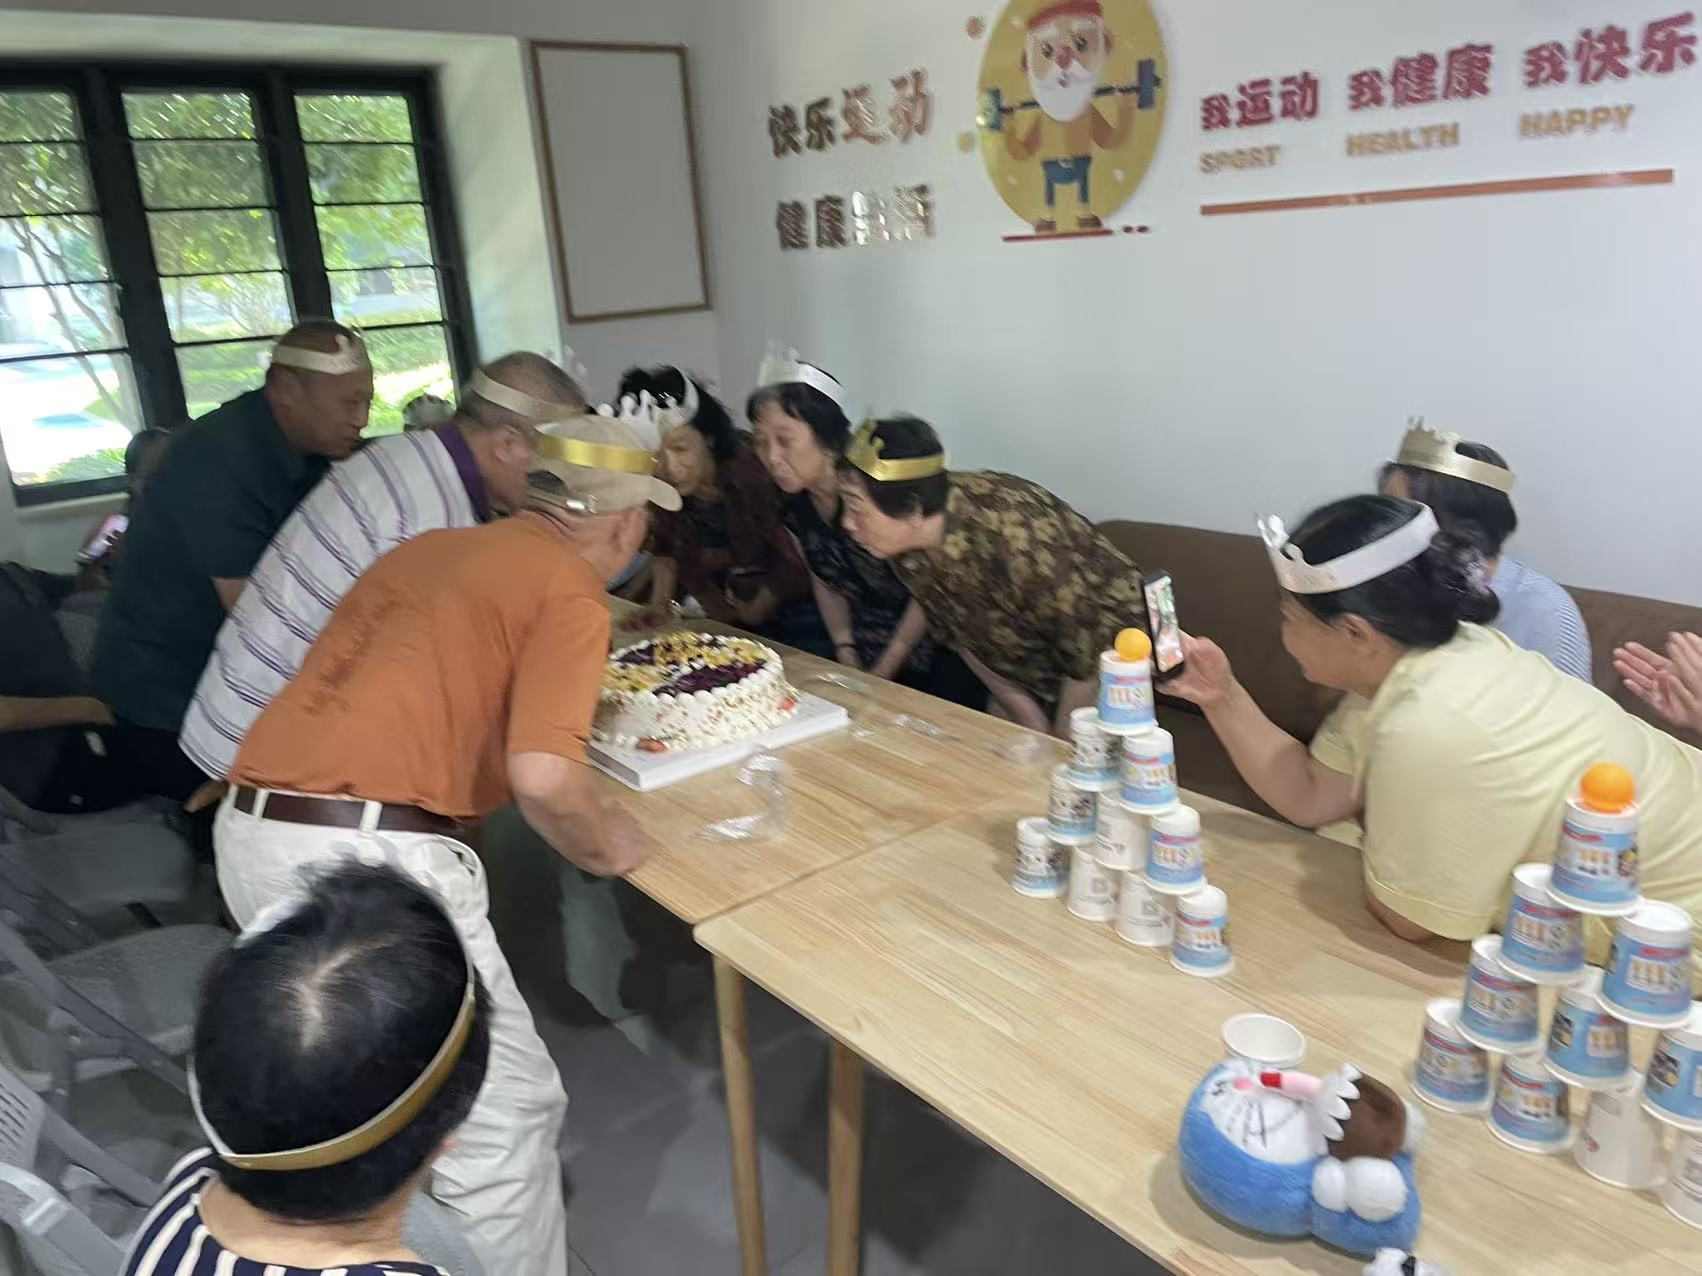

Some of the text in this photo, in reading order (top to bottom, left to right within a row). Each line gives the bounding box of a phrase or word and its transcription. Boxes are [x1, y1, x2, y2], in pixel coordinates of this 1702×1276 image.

[767, 67, 934, 158] 快乐运动
[1201, 11, 1697, 131] 我运动 我健康 我快乐
[1199, 103, 1635, 174] SPORT HEALTH HAPPY
